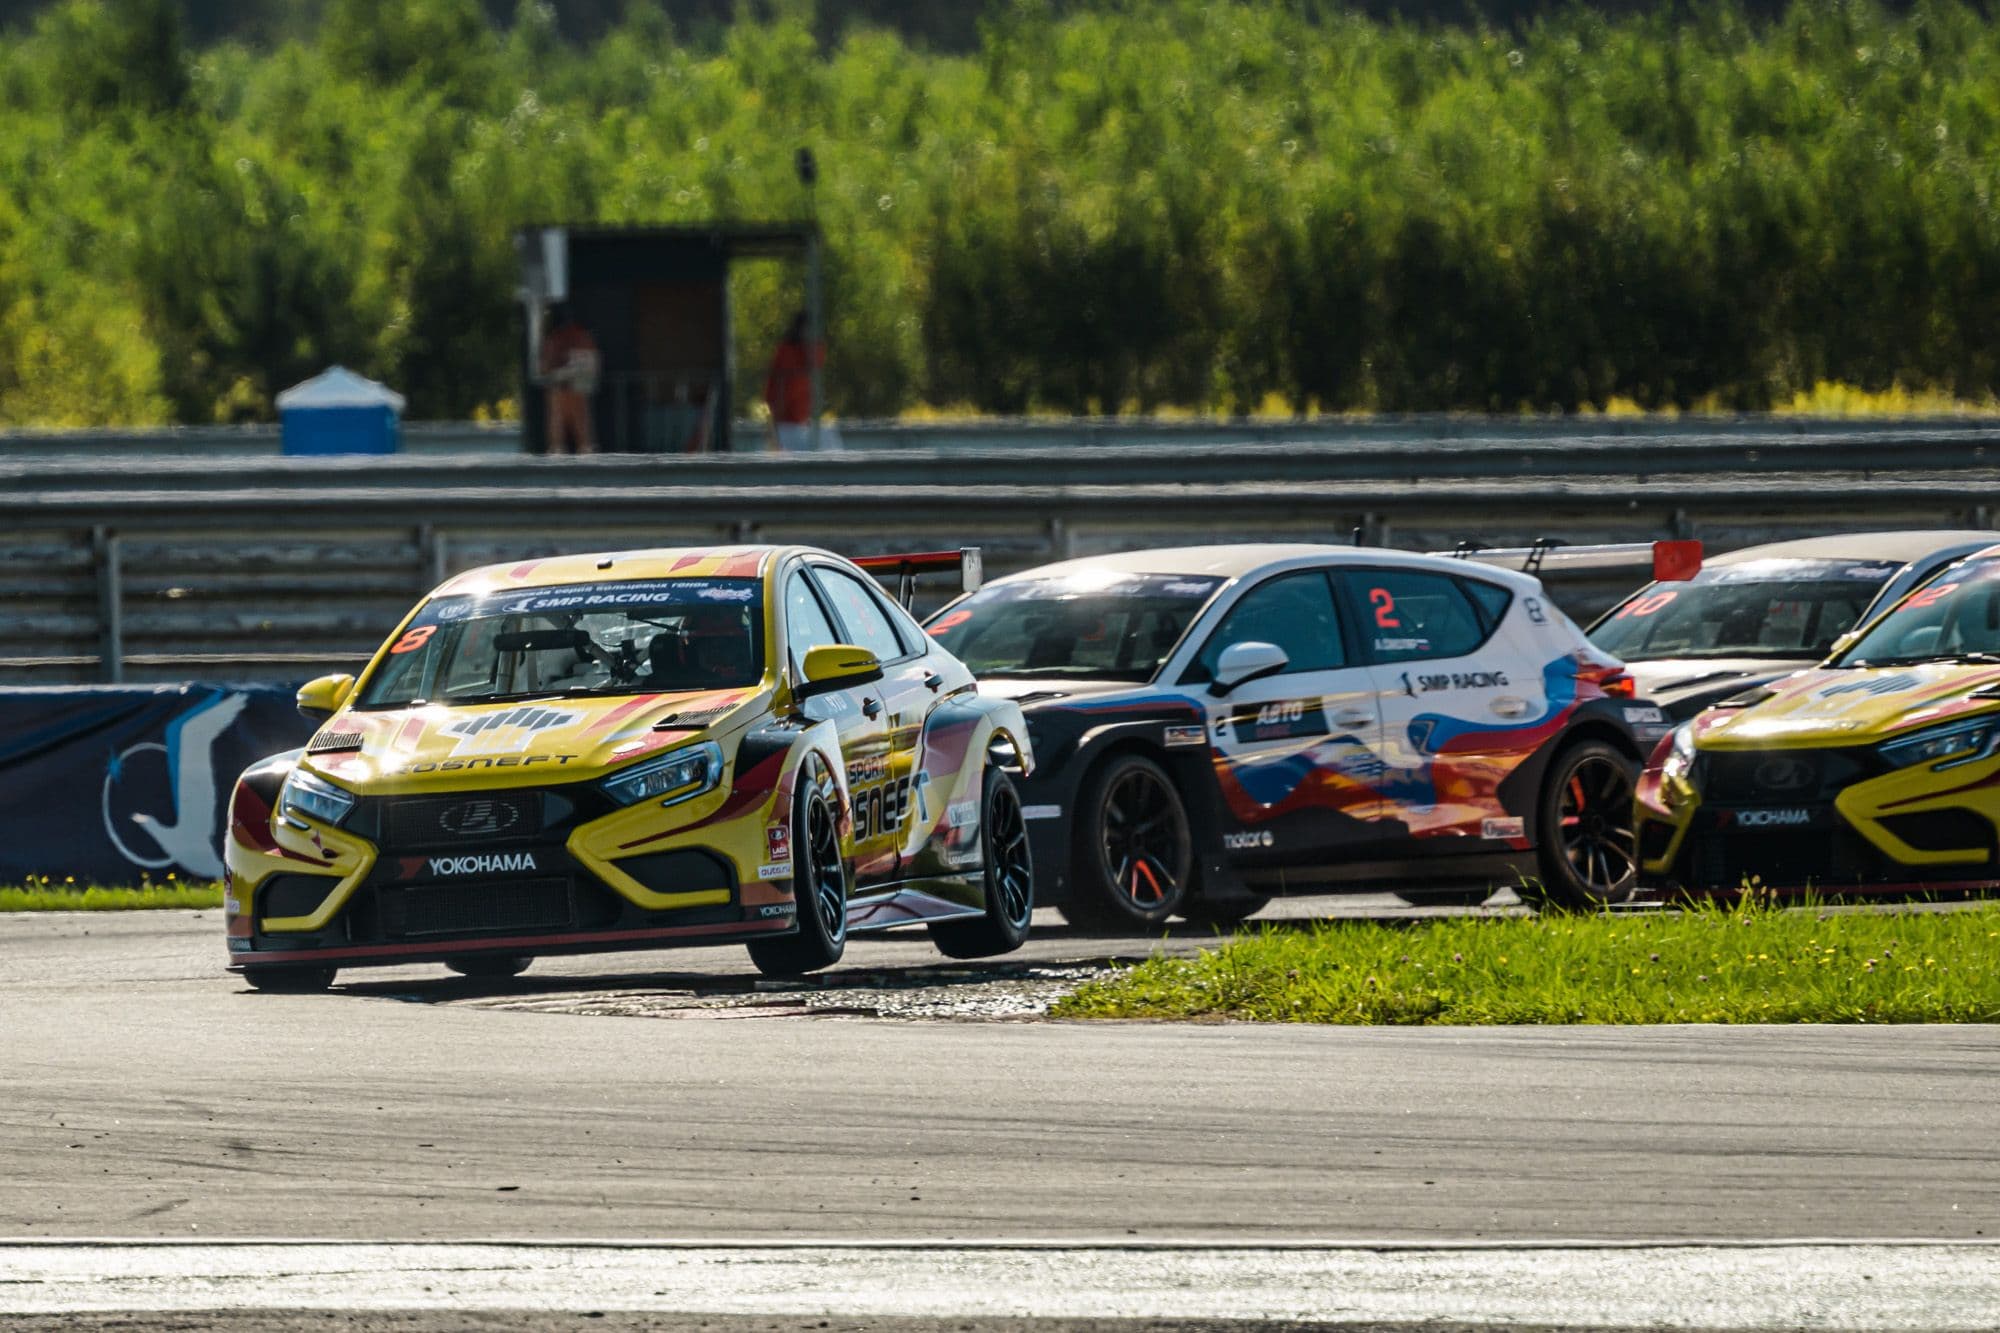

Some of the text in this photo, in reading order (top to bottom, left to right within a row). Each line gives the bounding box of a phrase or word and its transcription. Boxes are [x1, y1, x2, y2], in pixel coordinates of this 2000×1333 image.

[533, 593, 670, 609] SMP RACING
[1369, 588, 1400, 628] 2
[1616, 591, 1678, 620] 10
[390, 625, 438, 654] 8
[1418, 671, 1509, 691] SMP RACING
[849, 757, 886, 784] SPORT
[1735, 809, 1811, 825] YOKOHAMA
[428, 852, 537, 876] YOKOHAMA
